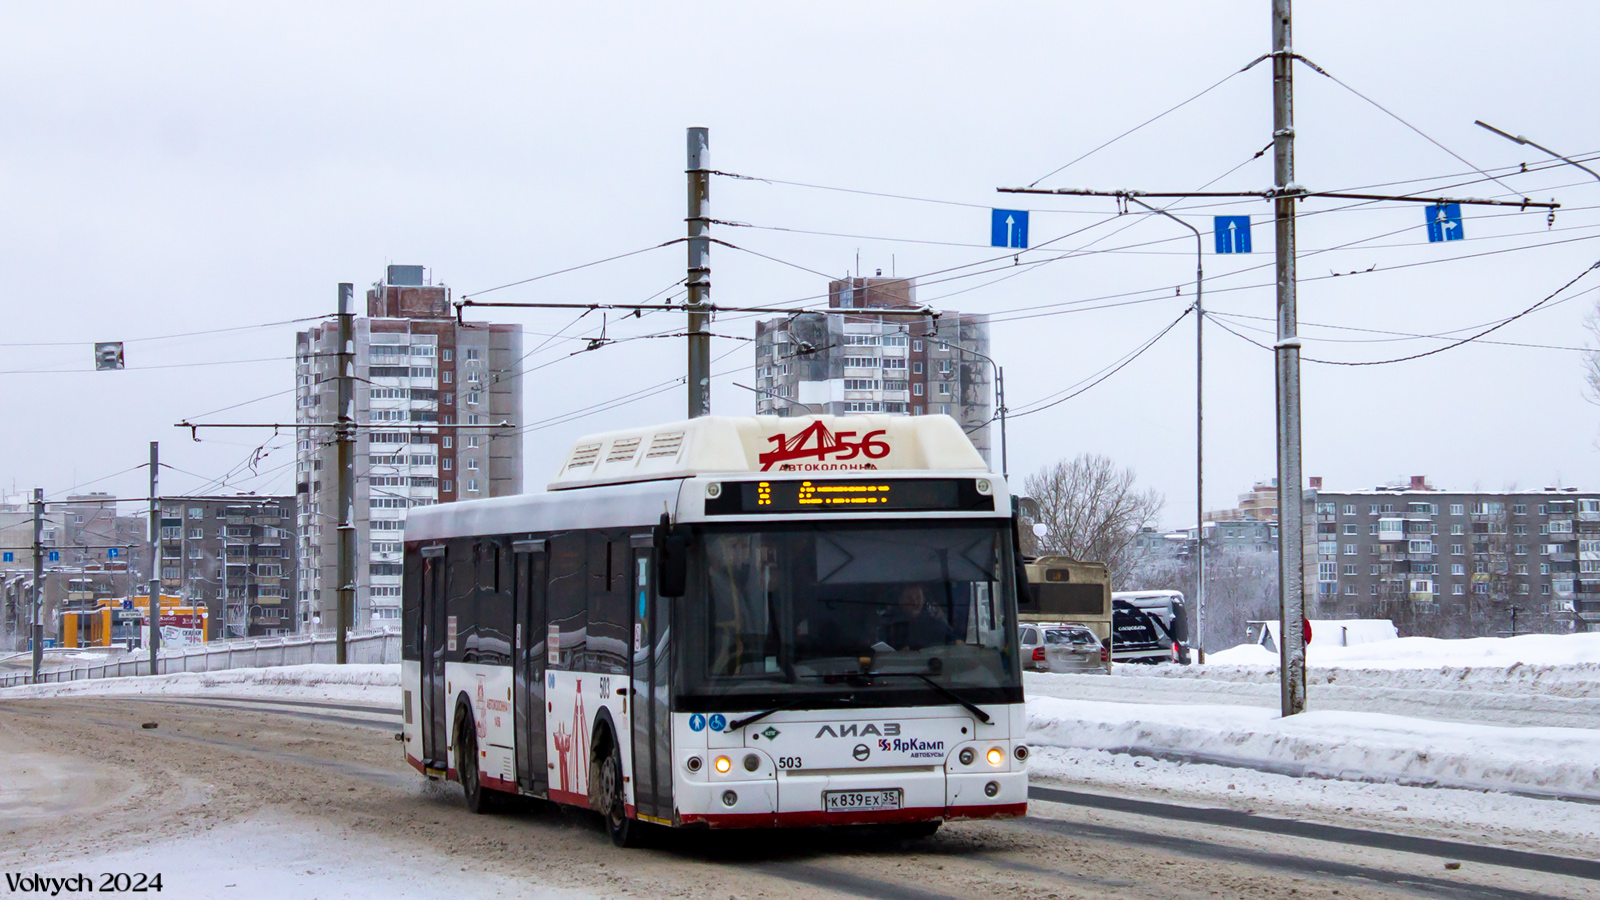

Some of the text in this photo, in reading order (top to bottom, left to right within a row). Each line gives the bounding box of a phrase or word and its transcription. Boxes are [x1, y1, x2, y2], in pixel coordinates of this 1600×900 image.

[766, 420, 891, 462] 1456
[779, 463, 878, 472] АВТОКОЛОННА
[599, 677, 610, 699] 503
[814, 722, 901, 738] ЛИАЗ
[893, 738, 944, 753] ЯрКамп
[778, 756, 802, 769] 503
